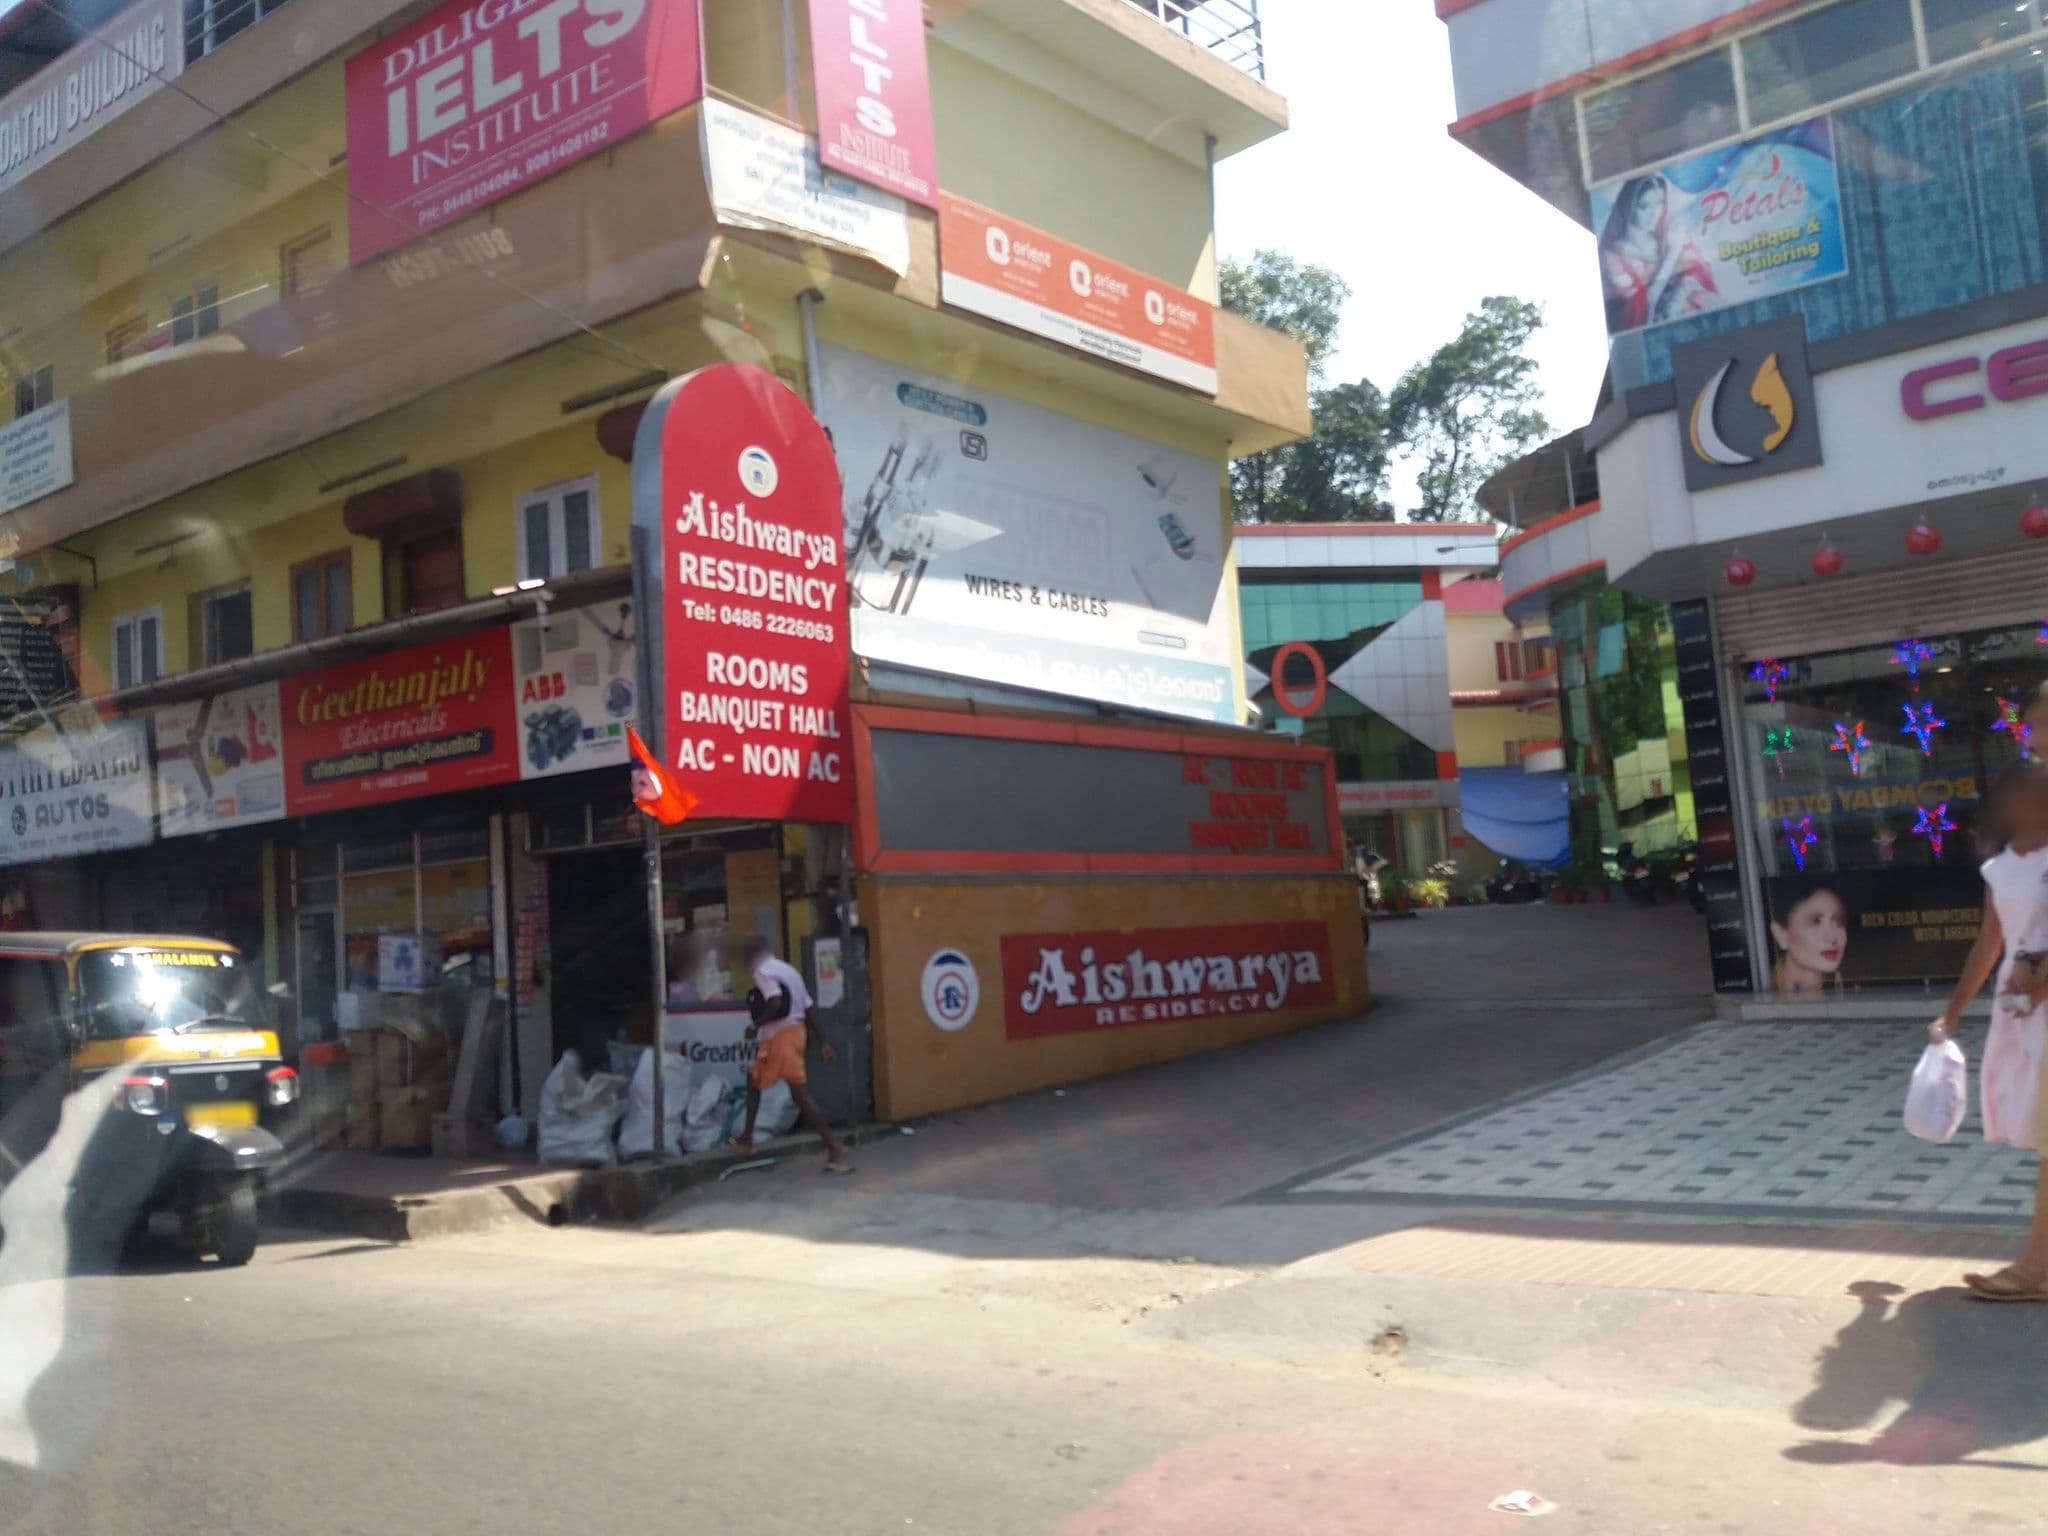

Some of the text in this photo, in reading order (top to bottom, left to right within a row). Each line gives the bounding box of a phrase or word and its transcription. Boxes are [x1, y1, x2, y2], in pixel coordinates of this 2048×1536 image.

[65, 13, 166, 133] BUILDING
[387, 0, 646, 158] IELTS
[411, 53, 614, 185] INSTITUTE
[1718, 216, 1821, 262] Boutique &
[1738, 241, 1821, 276] Tailoring
[676, 490, 838, 571] Aishwarya
[679, 551, 838, 613] RESIDENCY
[964, 573, 1109, 617] WIRES & CABLES
[682, 598, 717, 622] Tel:
[720, 604, 763, 630] 0486
[297, 648, 494, 727] Geethanjaly
[522, 671, 566, 704] ABB
[706, 651, 809, 696] ROOMS
[680, 690, 841, 738] BANQUET HALL
[677, 737, 717, 772] AC
[742, 743, 800, 780] NON
[807, 750, 841, 783] AC
[34, 794, 110, 828] AUTOS
[1020, 946, 1322, 1014] Aishwarya
[1096, 992, 1263, 1026] RESIDENCY
